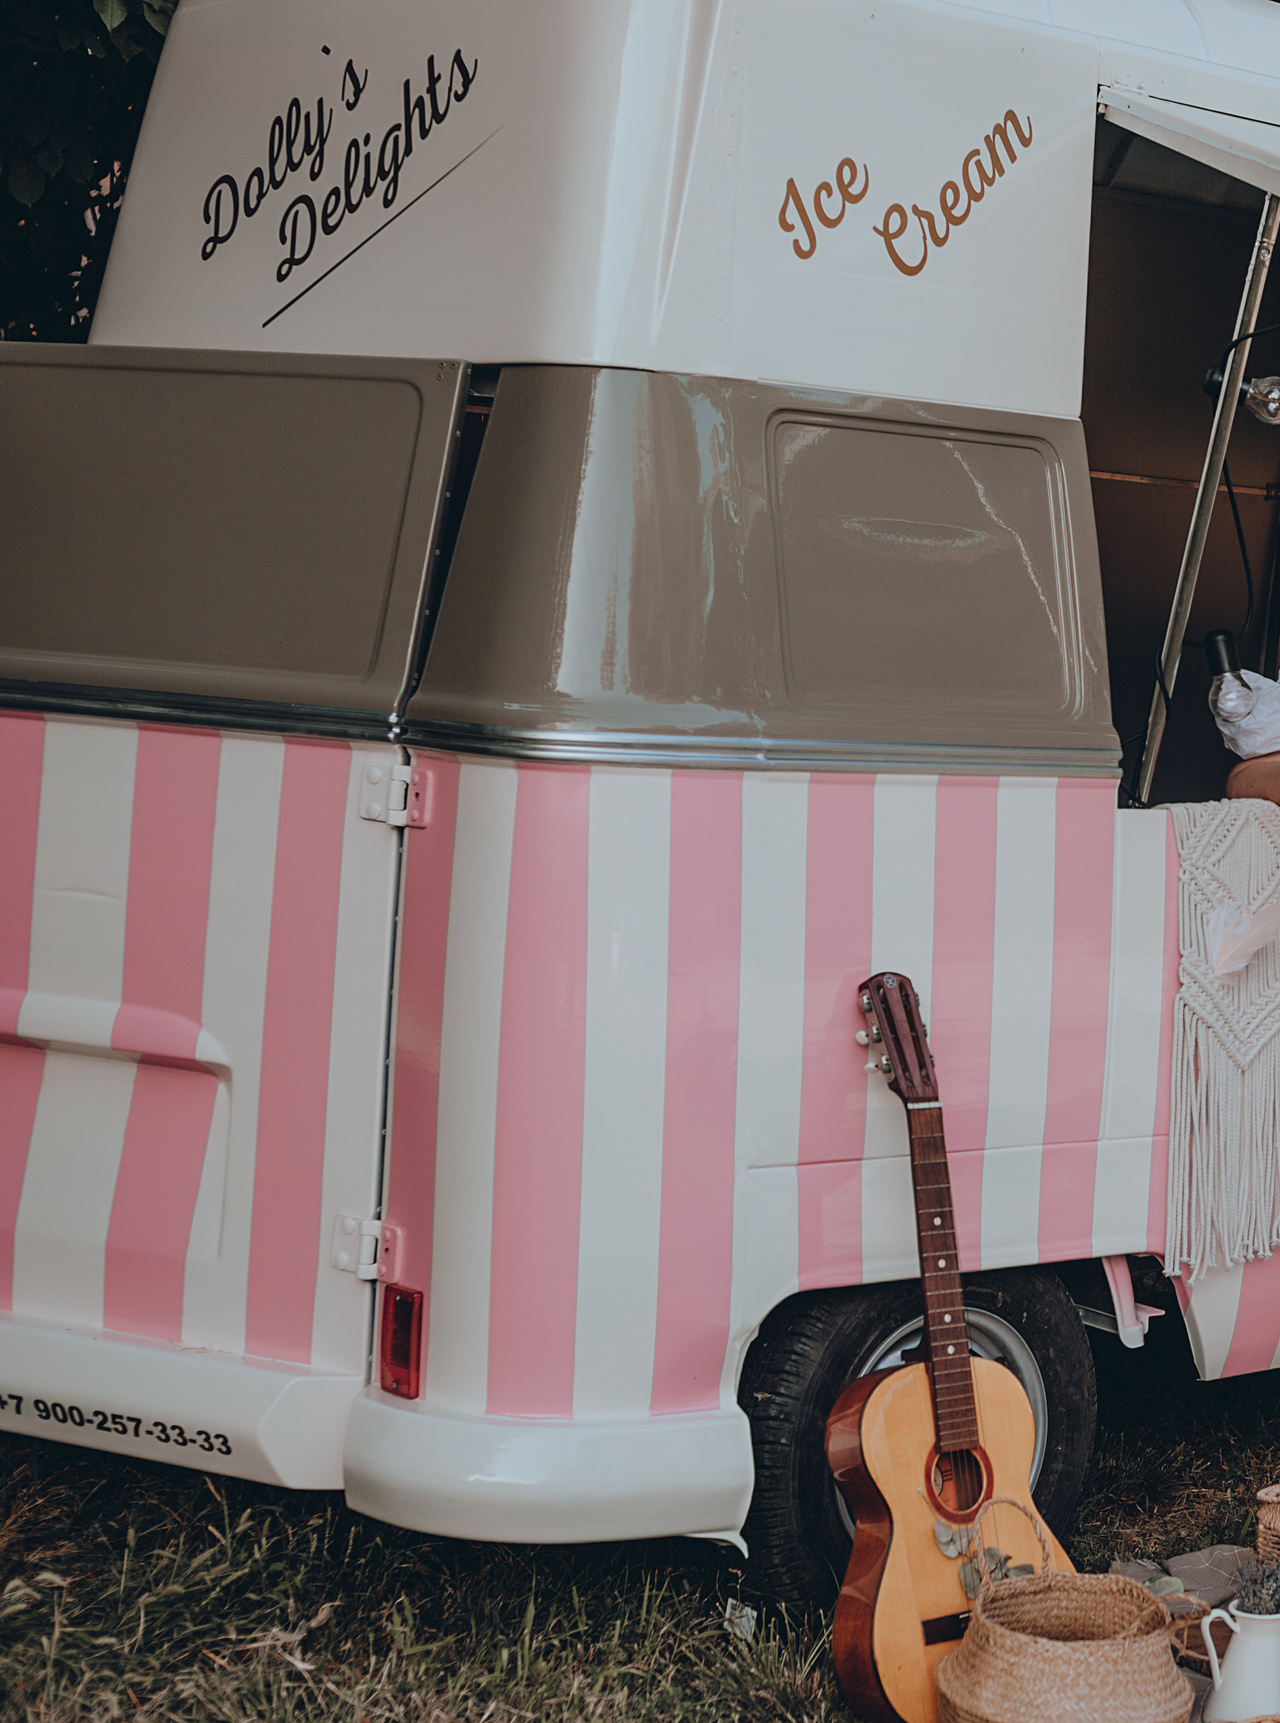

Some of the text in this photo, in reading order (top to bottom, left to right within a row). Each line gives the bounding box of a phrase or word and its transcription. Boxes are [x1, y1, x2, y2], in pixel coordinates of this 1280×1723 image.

[201, 45, 368, 261] Dolly's
[276, 49, 478, 282] Delights
[779, 157, 869, 260] Ice
[872, 109, 1033, 276] Cream
[34, 1399, 232, 1456] 900-257-33-33
